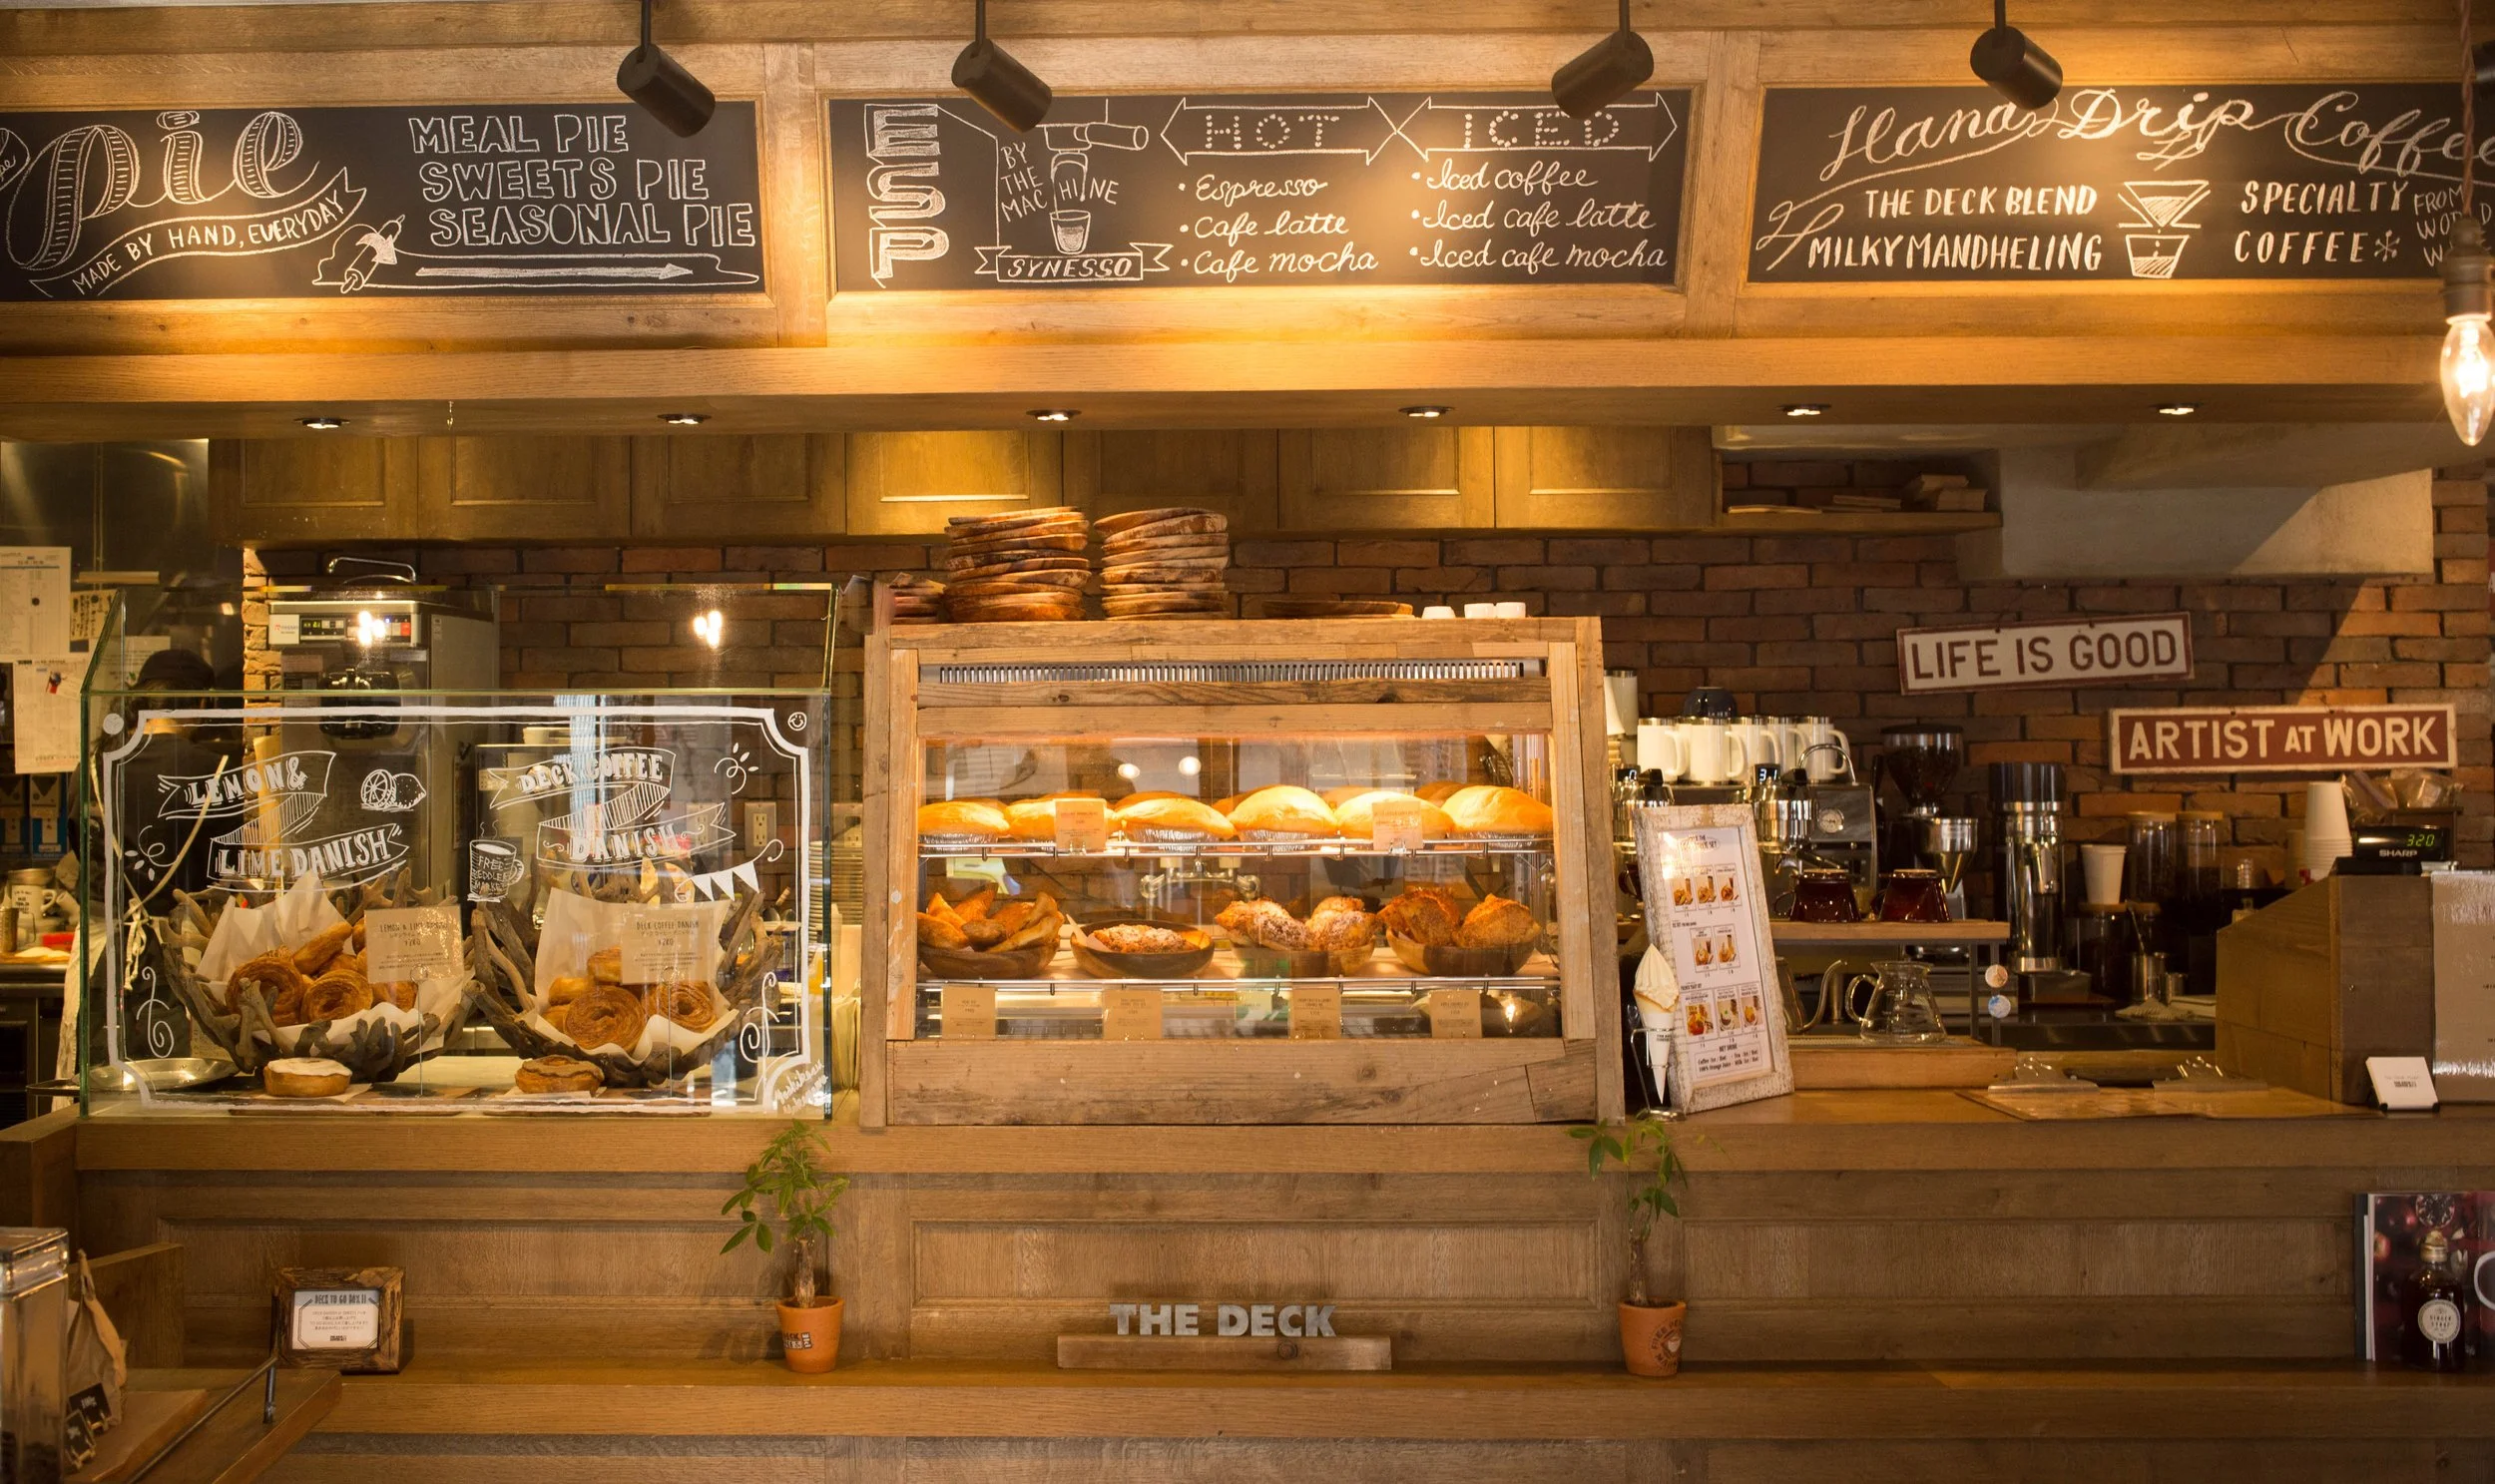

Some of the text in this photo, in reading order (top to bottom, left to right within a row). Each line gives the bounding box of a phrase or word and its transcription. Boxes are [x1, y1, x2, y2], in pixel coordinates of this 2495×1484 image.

[408, 114, 629, 154] MEAL PIE
[1205, 113, 1340, 149] HOT
[1464, 110, 1620, 149] ICED
[2058, 88, 2255, 160] Drip
[1001, 142, 1027, 170] BY
[419, 158, 710, 202] SWEETS PIE
[1001, 167, 1044, 195] THE
[1197, 174, 1327, 207] Espresso
[1426, 158, 1598, 195] Iced coffee
[1866, 185, 2097, 219] THE DECK BLEND
[2242, 181, 2409, 215] SPECIALTY
[2413, 184, 2465, 216] FROM
[430, 203, 755, 247] SEASONAL PIE
[1196, 211, 1349, 246] Cafe latte
[1423, 200, 1657, 240] Iced cafe latte
[73, 190, 346, 295] MADE BY HAND, EVERYDAY
[1419, 239, 1669, 274] Iced cafe mocha
[1808, 233, 2101, 270] MILKY MANDHELING
[2235, 231, 2368, 264] COFFEE
[1007, 256, 1133, 278] SYNESSO
[1195, 242, 1378, 283] Cafe mocha
[1911, 629, 2178, 680] LIFE IS GOOD
[2129, 716, 2438, 761] ARTIST AT WORK
[516, 753, 663, 793] DECK COFFEE
[216, 829, 391, 877] LIME DANISH
[567, 823, 681, 862] DANISH
[2406, 833, 2435, 847] 320
[1109, 1303, 1337, 1337] THE DECK
